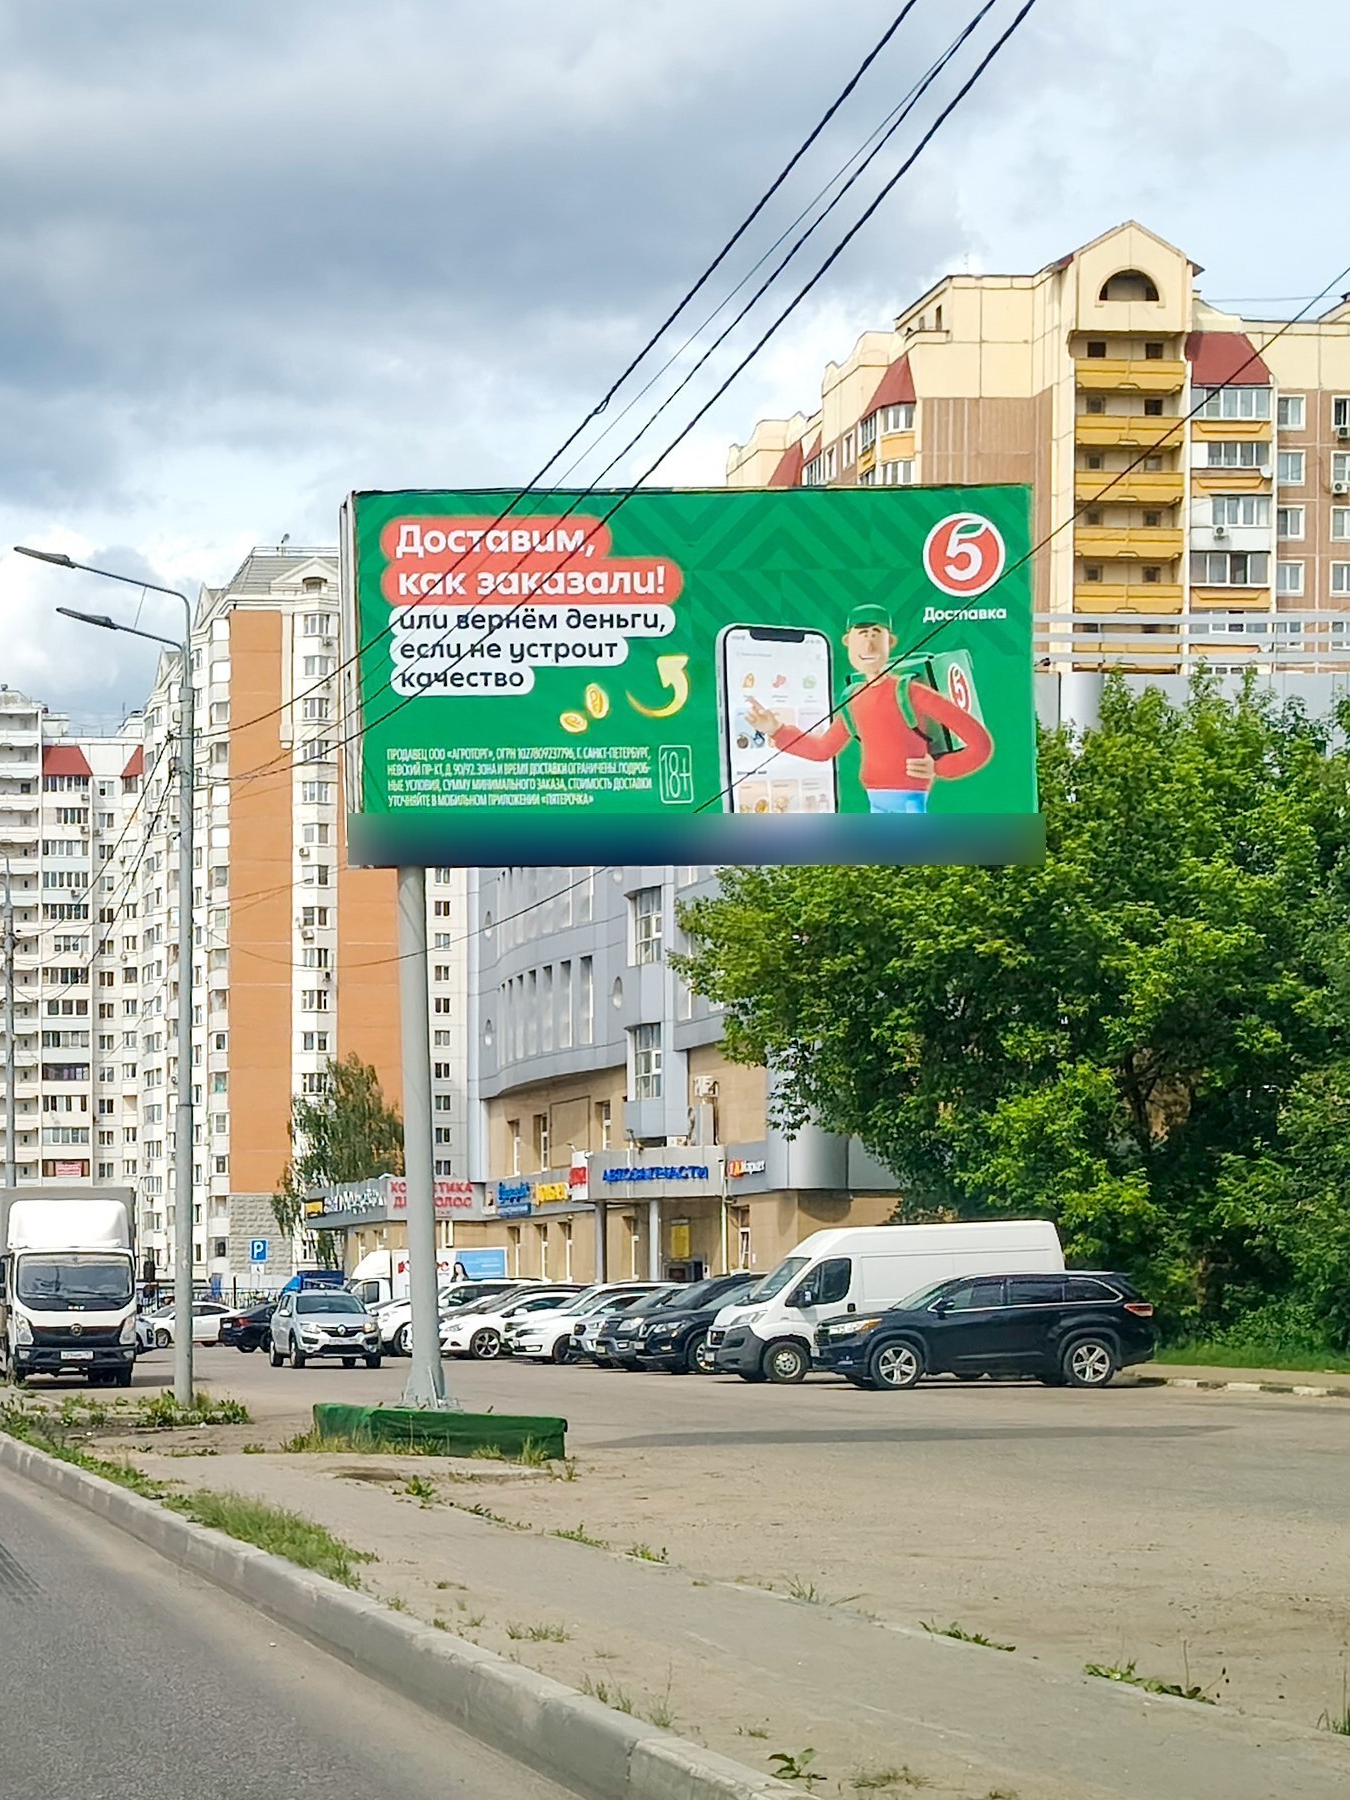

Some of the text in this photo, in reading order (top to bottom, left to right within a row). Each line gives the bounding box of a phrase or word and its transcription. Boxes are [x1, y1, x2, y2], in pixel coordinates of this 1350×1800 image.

[395, 524, 596, 558] Доставим,
[399, 565, 665, 596] как заказали!
[399, 607, 666, 634] или вернём деньги,
[922, 606, 1008, 624] Доставка
[401, 642, 618, 664] если не устроит
[400, 671, 525, 689] качество
[386, 748, 428, 761] ПРОДАВЕЦ
[429, 748, 445, 760] ООО
[496, 748, 516, 760] ОГРН
[387, 762, 421, 776] НЕВСКИЙ
[504, 763, 528, 776] ВРЕМЯ
[529, 763, 567, 776] ДОСТАВКИ
[660, 751, 690, 799] 18+
[387, 779, 404, 791] НЫЕ
[442, 778, 471, 791] СУММУ
[472, 778, 536, 791] МИНИМАЛЬНОГО
[567, 777, 612, 790] СТОИМОСТЬ
[613, 777, 652, 790] ДОСТАВКИ
[388, 792, 430, 807] УТОЧНЯЙТЕ
[431, 794, 437, 806] В
[438, 794, 487, 806] МОБИЛЬНОМ
[488, 793, 540, 806] ПРИЛОЖЕНИИ
[433, 1196, 473, 1208] ОЛОС
